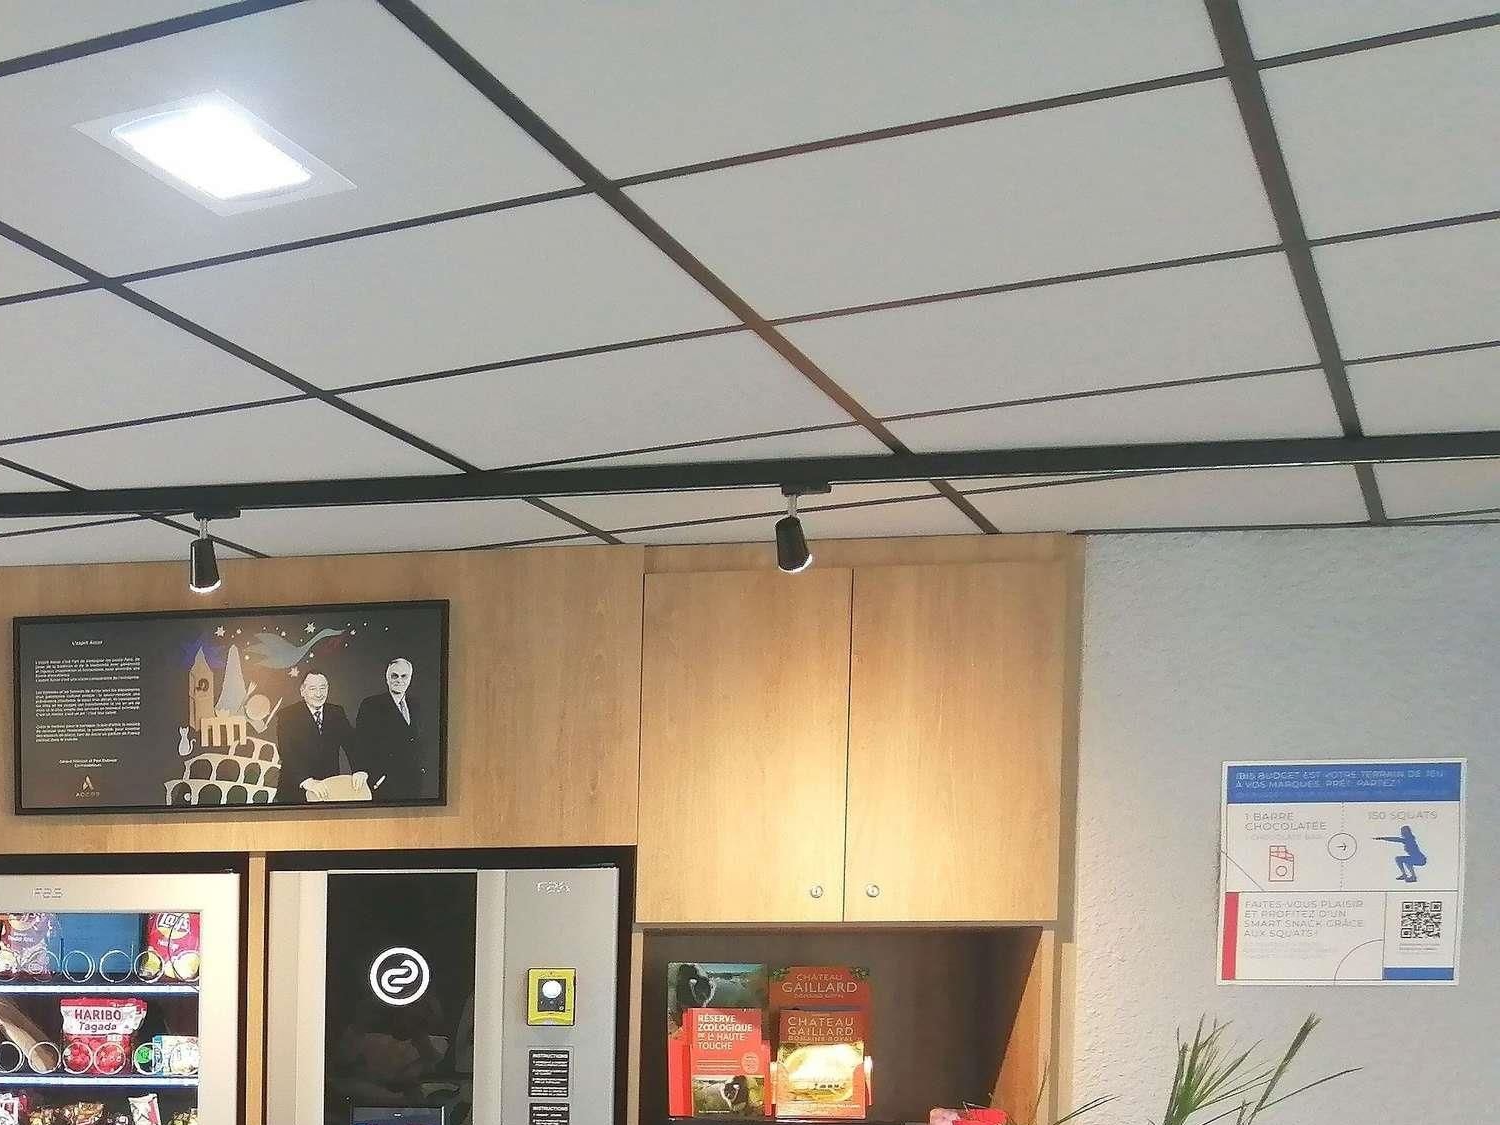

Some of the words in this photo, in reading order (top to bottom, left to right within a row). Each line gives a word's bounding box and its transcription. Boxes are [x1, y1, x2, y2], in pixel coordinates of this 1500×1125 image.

[1389, 810, 1438, 820] SQUATS
[1244, 920, 1282, 928] SMART
[1285, 920, 1323, 928] SNACK
[781, 982, 858, 993] GAILLARD
[74, 1009, 122, 1020] HARIBO
[79, 1022, 117, 1033] Tagada
[698, 1024, 753, 1032] ZOOLOGIQUE
[788, 1026, 854, 1036] GAILLARD
[698, 1042, 733, 1050] TOUCHE
